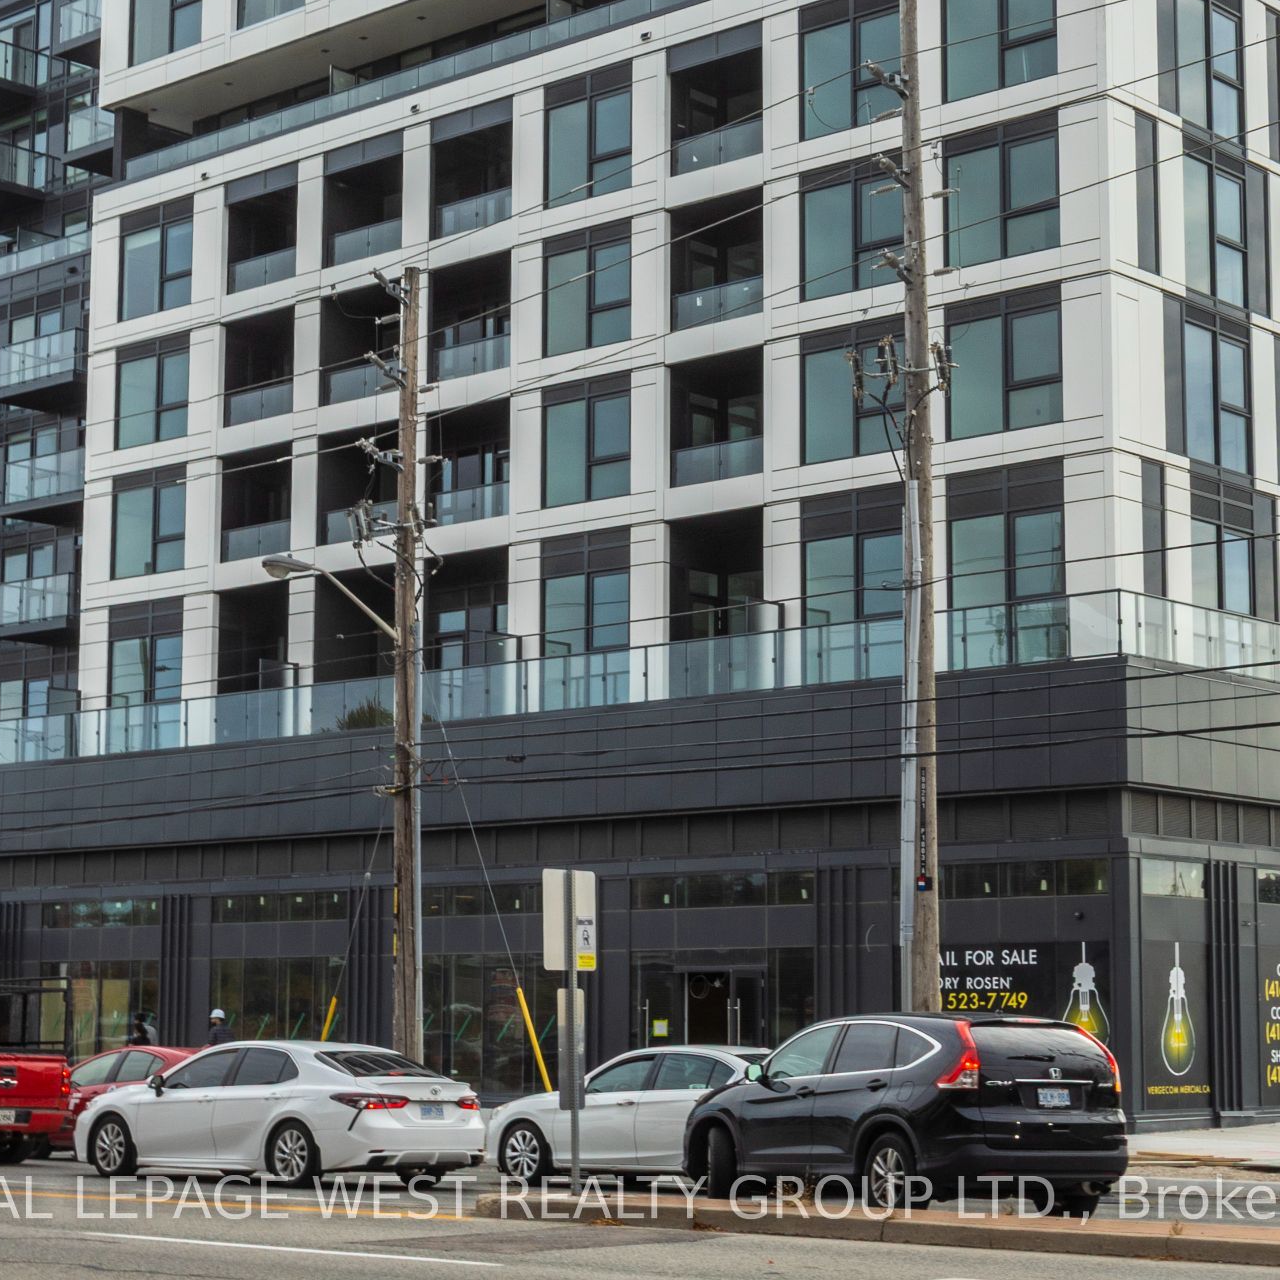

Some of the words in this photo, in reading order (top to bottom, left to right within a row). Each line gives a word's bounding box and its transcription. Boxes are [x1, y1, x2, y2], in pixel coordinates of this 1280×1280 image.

[938, 950, 958, 966] AIL
[965, 950, 995, 966] FOR
[1001, 949, 1038, 965] SALE
[939, 977, 960, 990] ORY
[966, 977, 1012, 990] ROSEN
[947, 992, 1028, 1010] 523-7749
